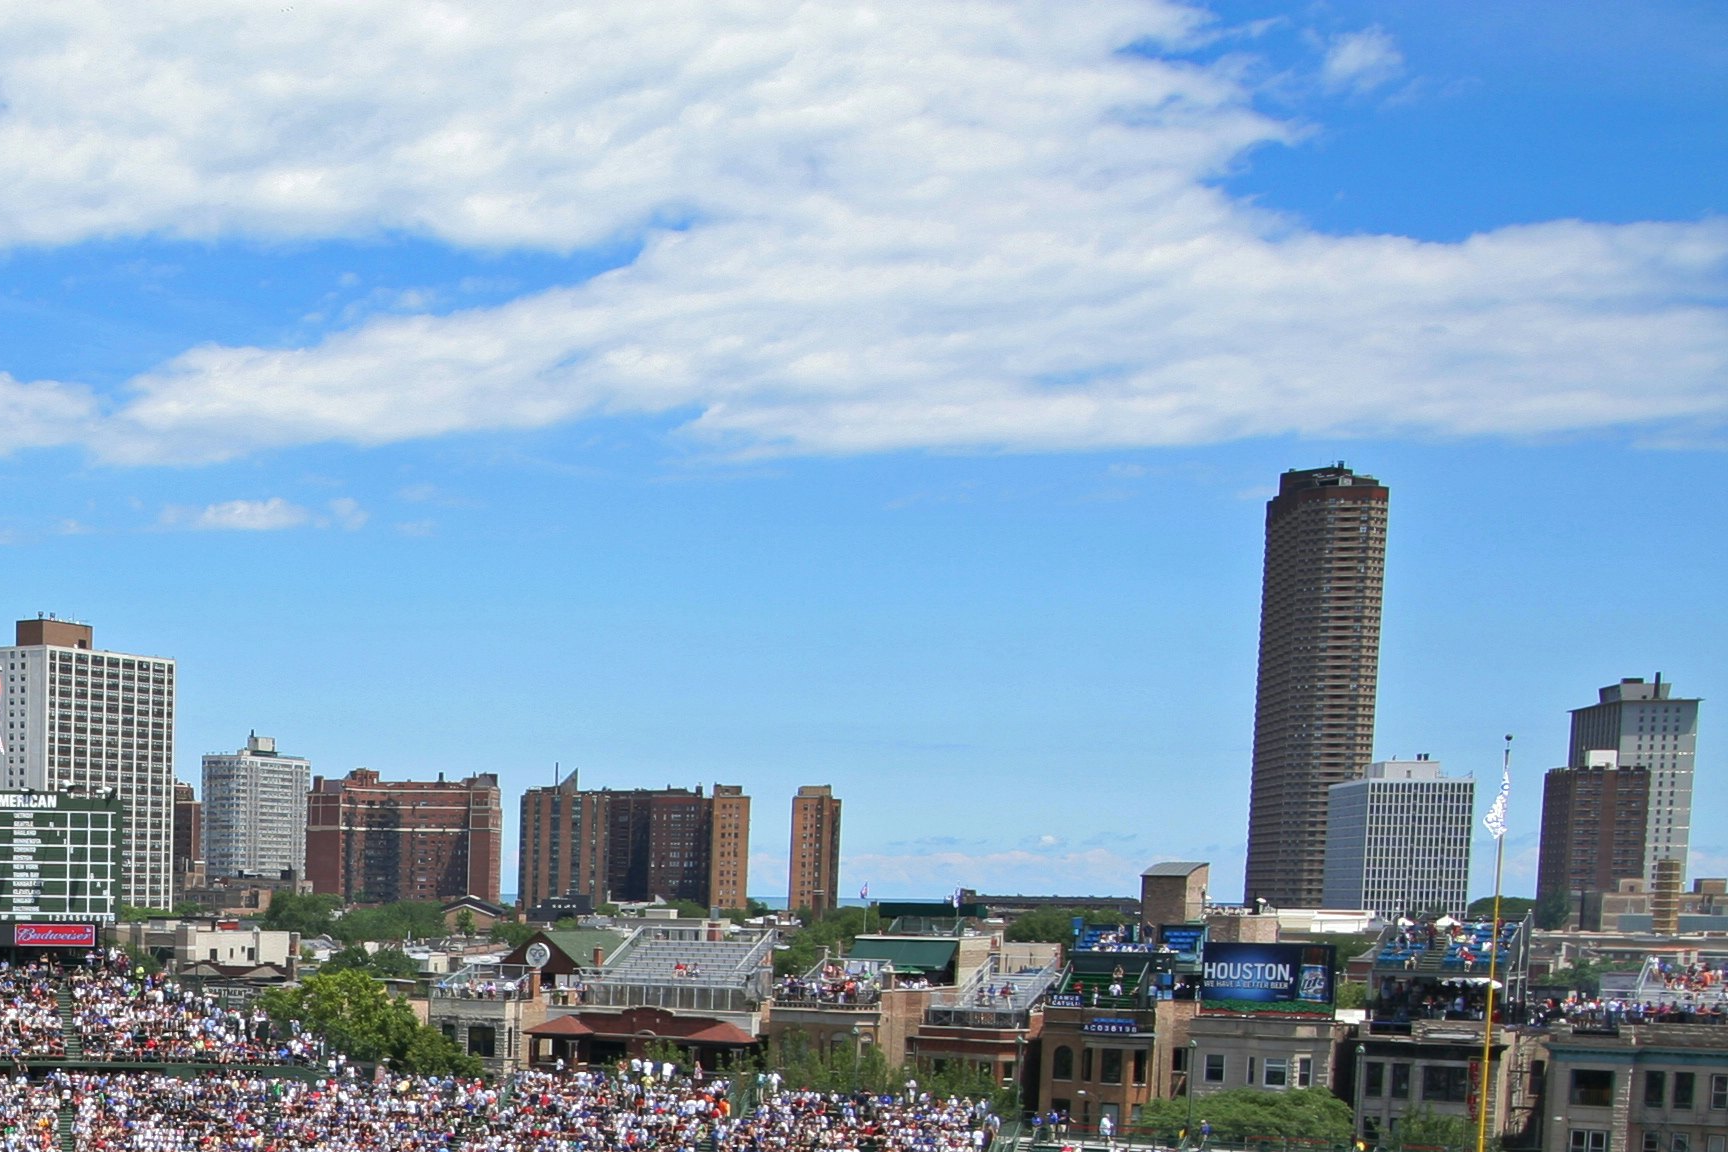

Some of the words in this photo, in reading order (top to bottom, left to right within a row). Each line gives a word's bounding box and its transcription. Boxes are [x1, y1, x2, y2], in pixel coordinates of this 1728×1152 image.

[16, 927, 91, 941] Budweiser
[1204, 962, 1293, 983] HOUSTON,
[1243, 981, 1269, 989] BETTER
